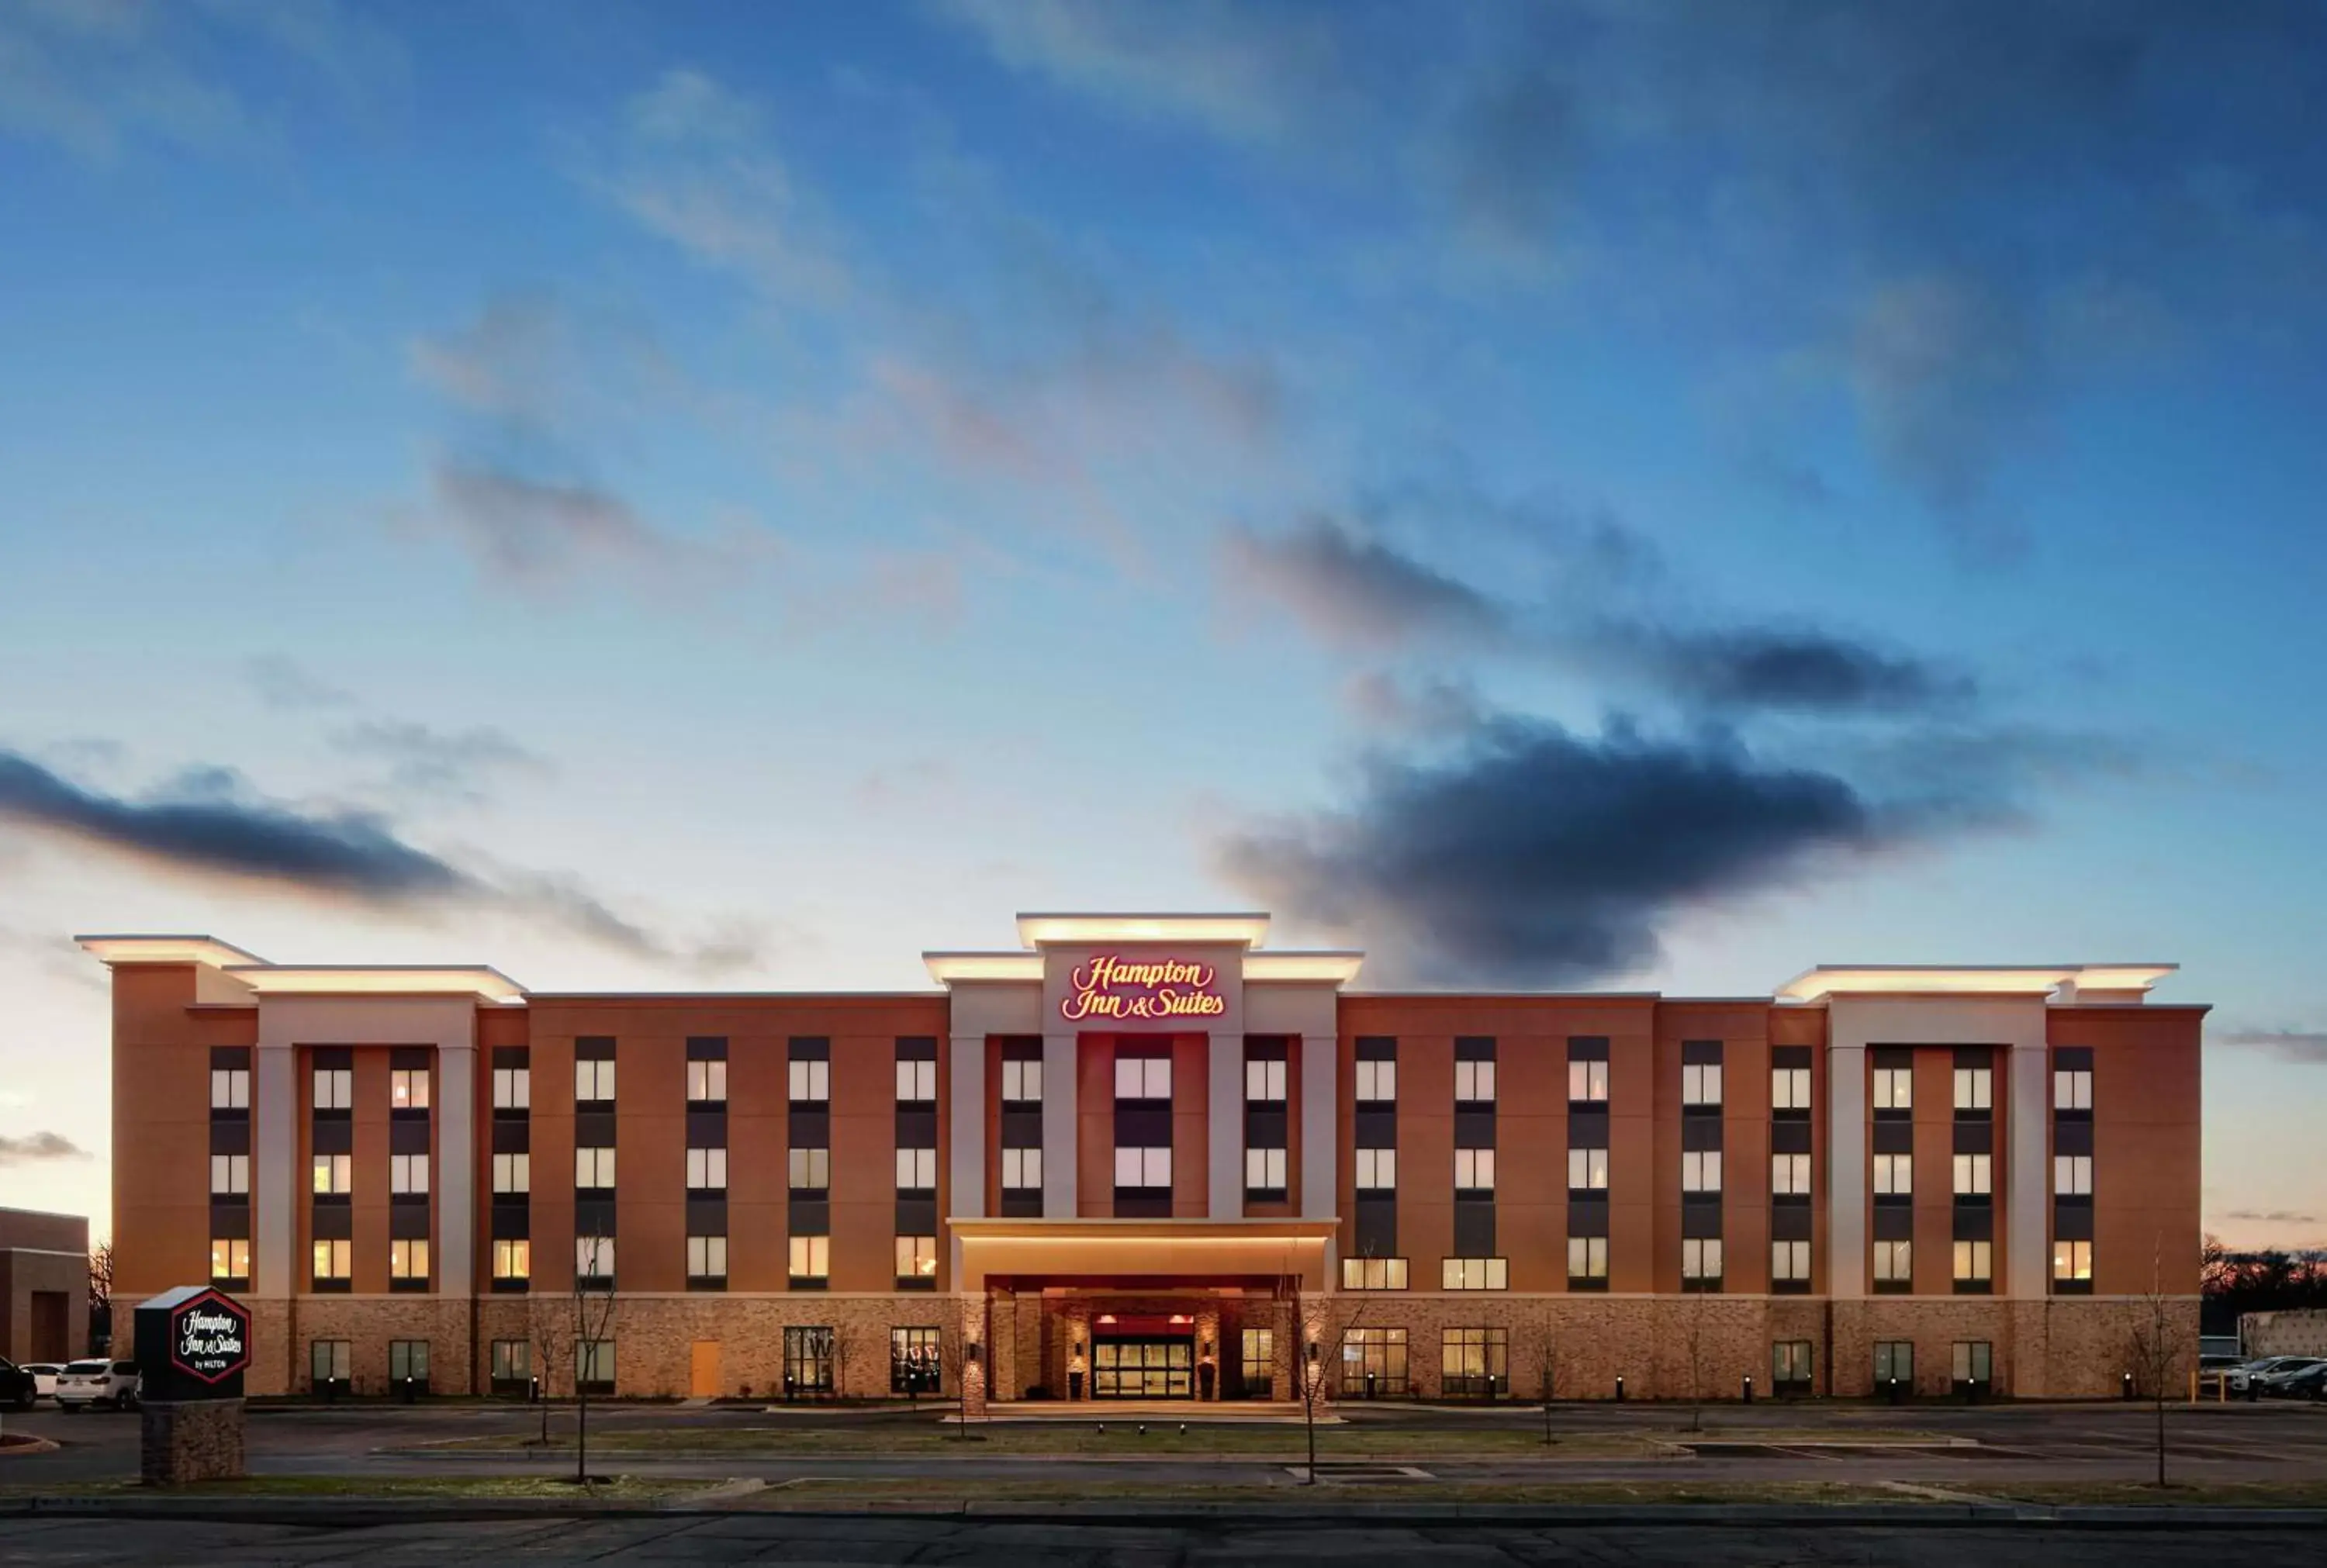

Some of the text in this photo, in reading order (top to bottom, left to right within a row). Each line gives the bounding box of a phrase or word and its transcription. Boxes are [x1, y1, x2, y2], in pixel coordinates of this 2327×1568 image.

[1074, 955, 1214, 990] Hampton
[1062, 989, 1225, 1019] Inn & Suites
[182, 1310, 236, 1335] Hampton
[195, 1359, 226, 1369] by HILTON
